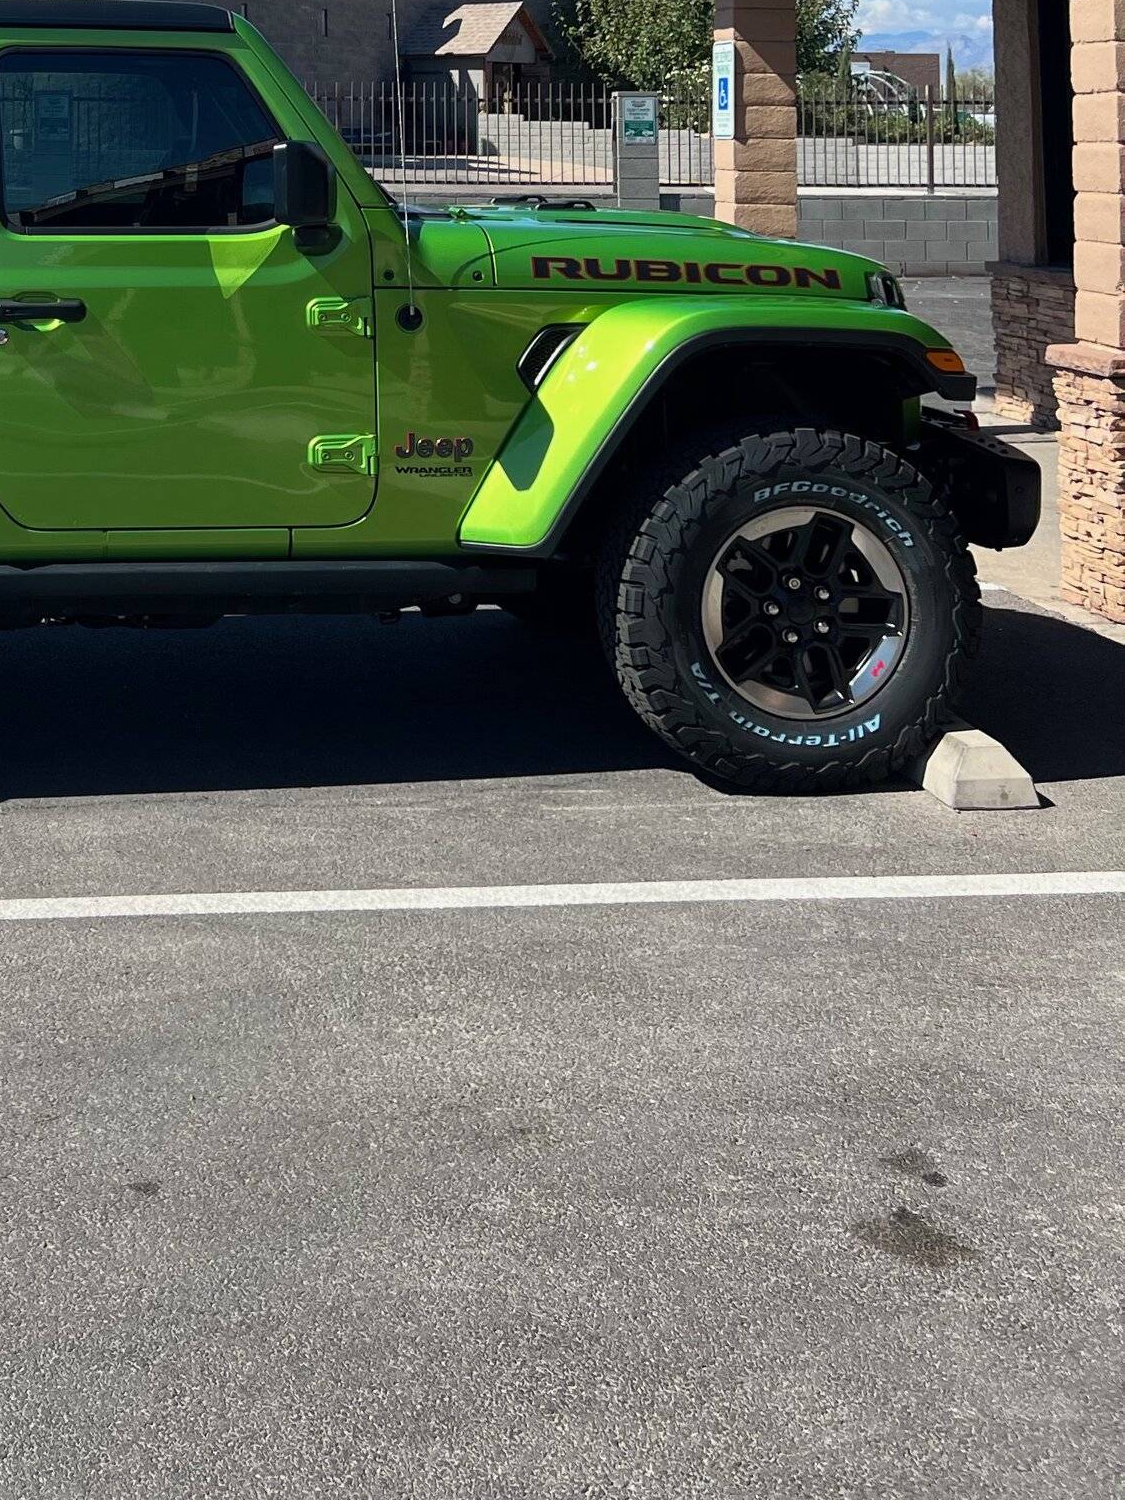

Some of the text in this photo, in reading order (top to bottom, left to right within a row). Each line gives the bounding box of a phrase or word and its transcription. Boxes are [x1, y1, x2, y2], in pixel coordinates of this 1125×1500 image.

[530, 256, 842, 290] RUBICON
[394, 431, 475, 462] Jeep
[395, 466, 473, 474] WRANGLER
[753, 481, 915, 547] BFGoodrich
[729, 710, 881, 747] All-Terrain
